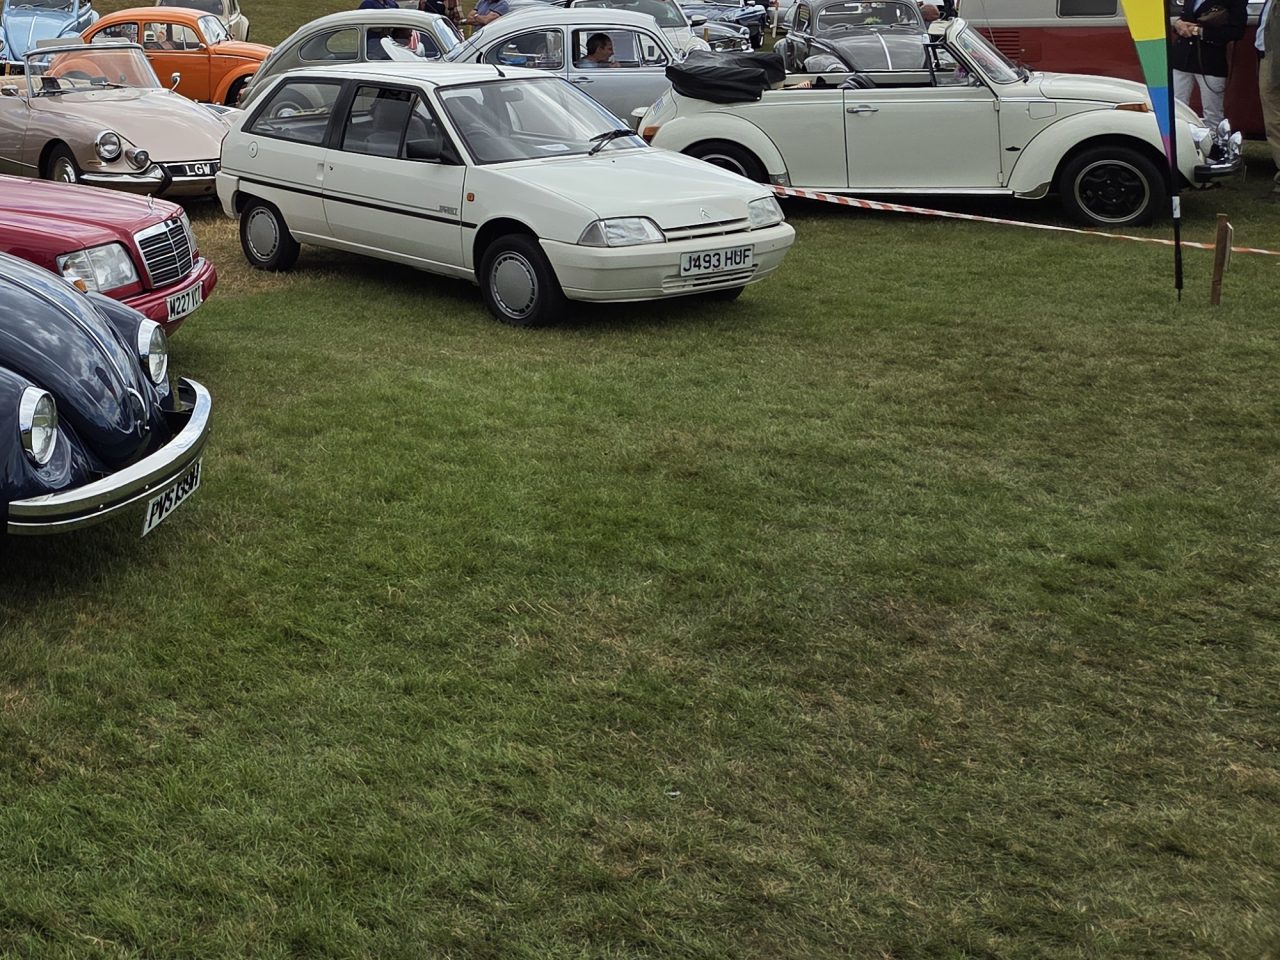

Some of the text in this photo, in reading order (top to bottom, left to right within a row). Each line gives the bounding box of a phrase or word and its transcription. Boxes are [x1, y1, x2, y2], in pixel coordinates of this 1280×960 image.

[185, 163, 211, 176] LGW
[683, 248, 752, 272] J493 HUF
